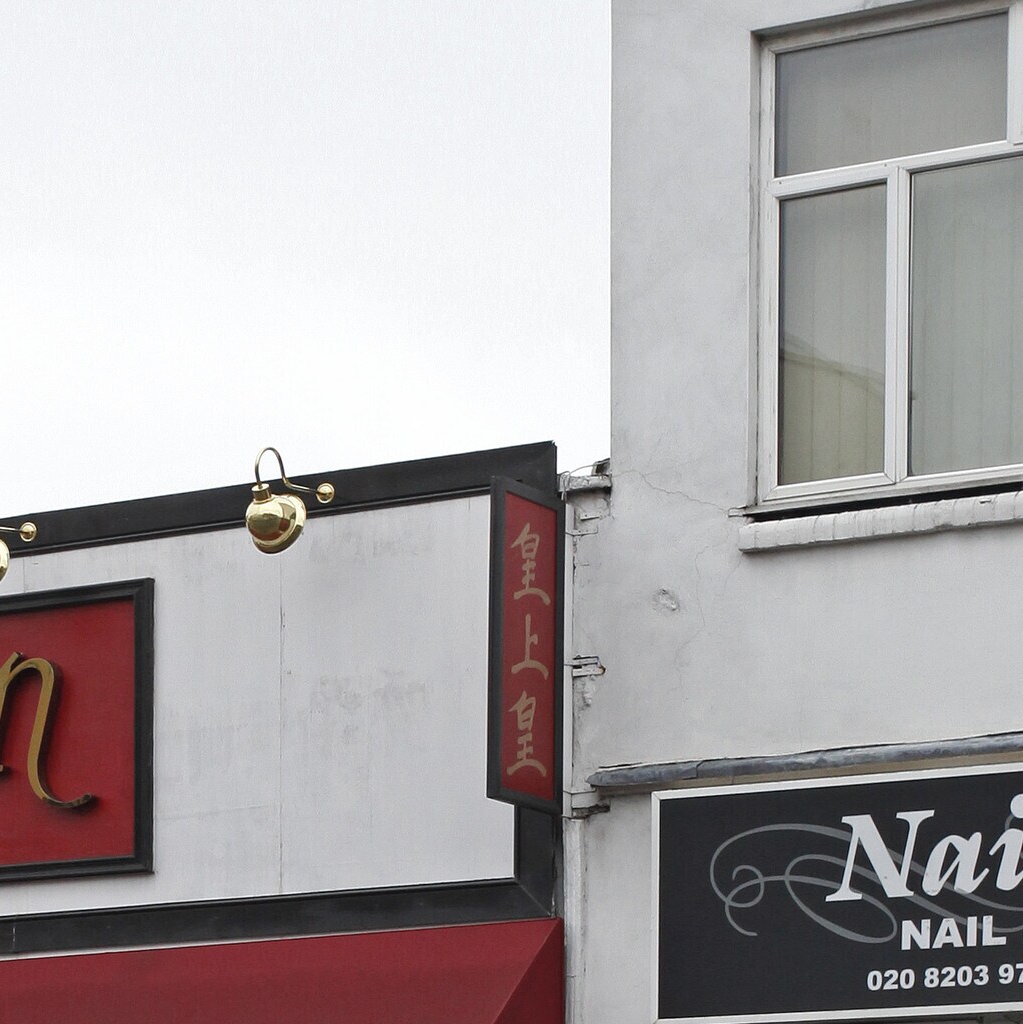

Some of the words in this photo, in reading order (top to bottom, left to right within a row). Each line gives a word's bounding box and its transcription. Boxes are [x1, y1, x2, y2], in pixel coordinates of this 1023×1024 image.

[901, 915, 1007, 950] NAIL
[867, 969, 915, 990] 020
[924, 964, 989, 988] 8203
